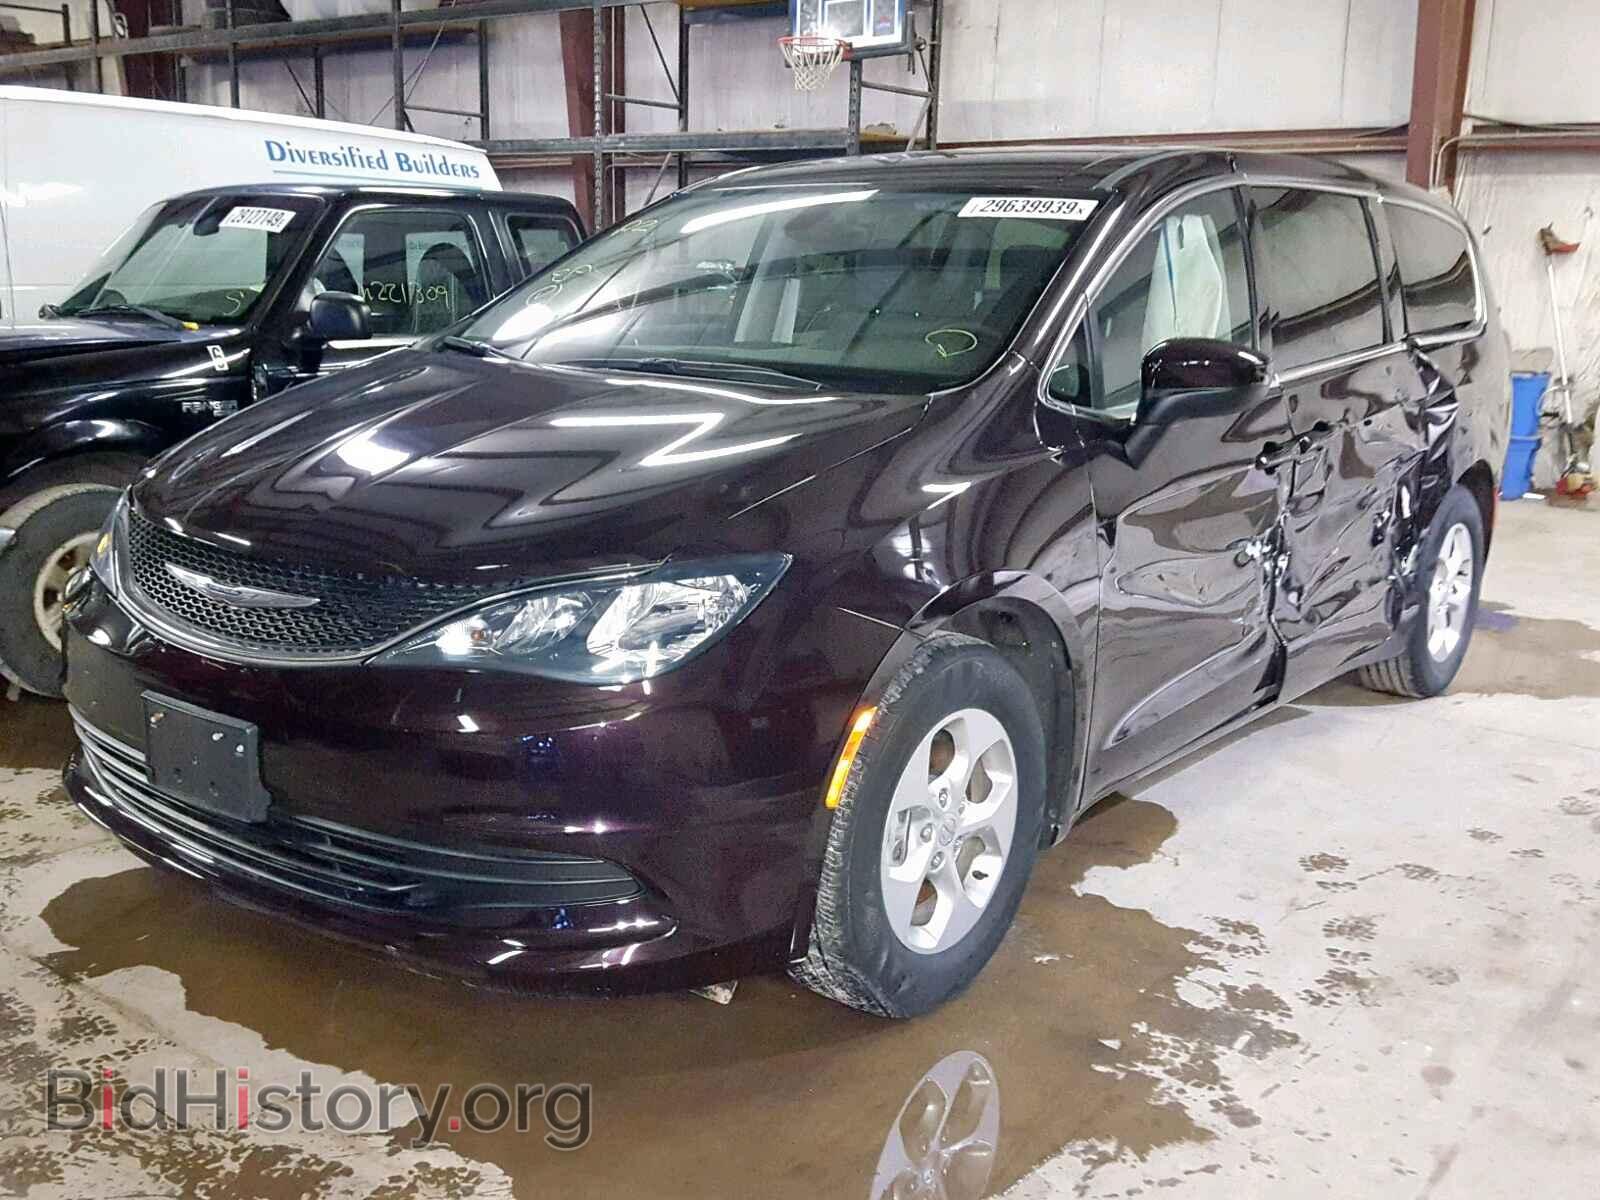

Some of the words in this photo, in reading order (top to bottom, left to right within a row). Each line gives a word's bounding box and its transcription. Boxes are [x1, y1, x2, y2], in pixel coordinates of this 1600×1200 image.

[264, 139, 389, 170] Diversified
[396, 153, 480, 179] Builders
[979, 199, 1079, 214] 29639939
